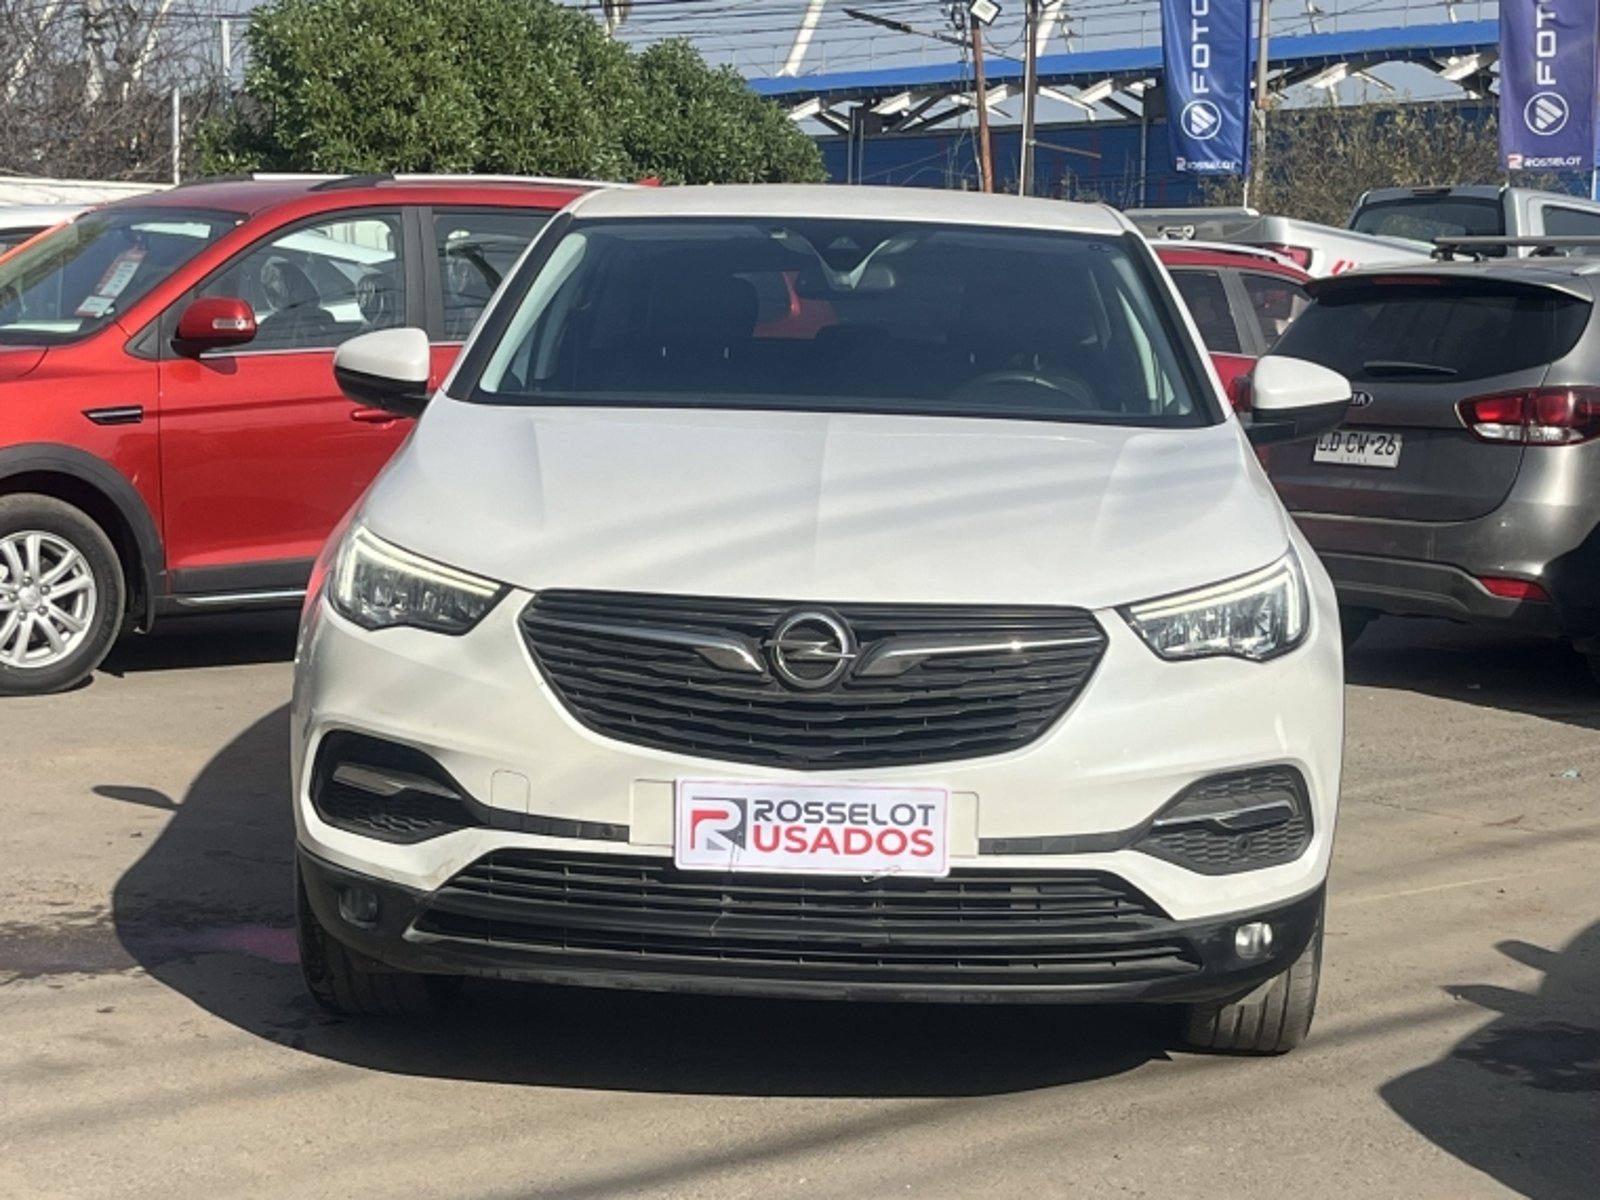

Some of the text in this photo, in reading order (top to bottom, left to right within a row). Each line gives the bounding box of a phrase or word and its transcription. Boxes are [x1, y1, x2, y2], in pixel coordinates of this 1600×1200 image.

[1536, 0, 1557, 86] FOT
[753, 799, 936, 827] ROSSELOT
[753, 825, 935, 857] USADOS
